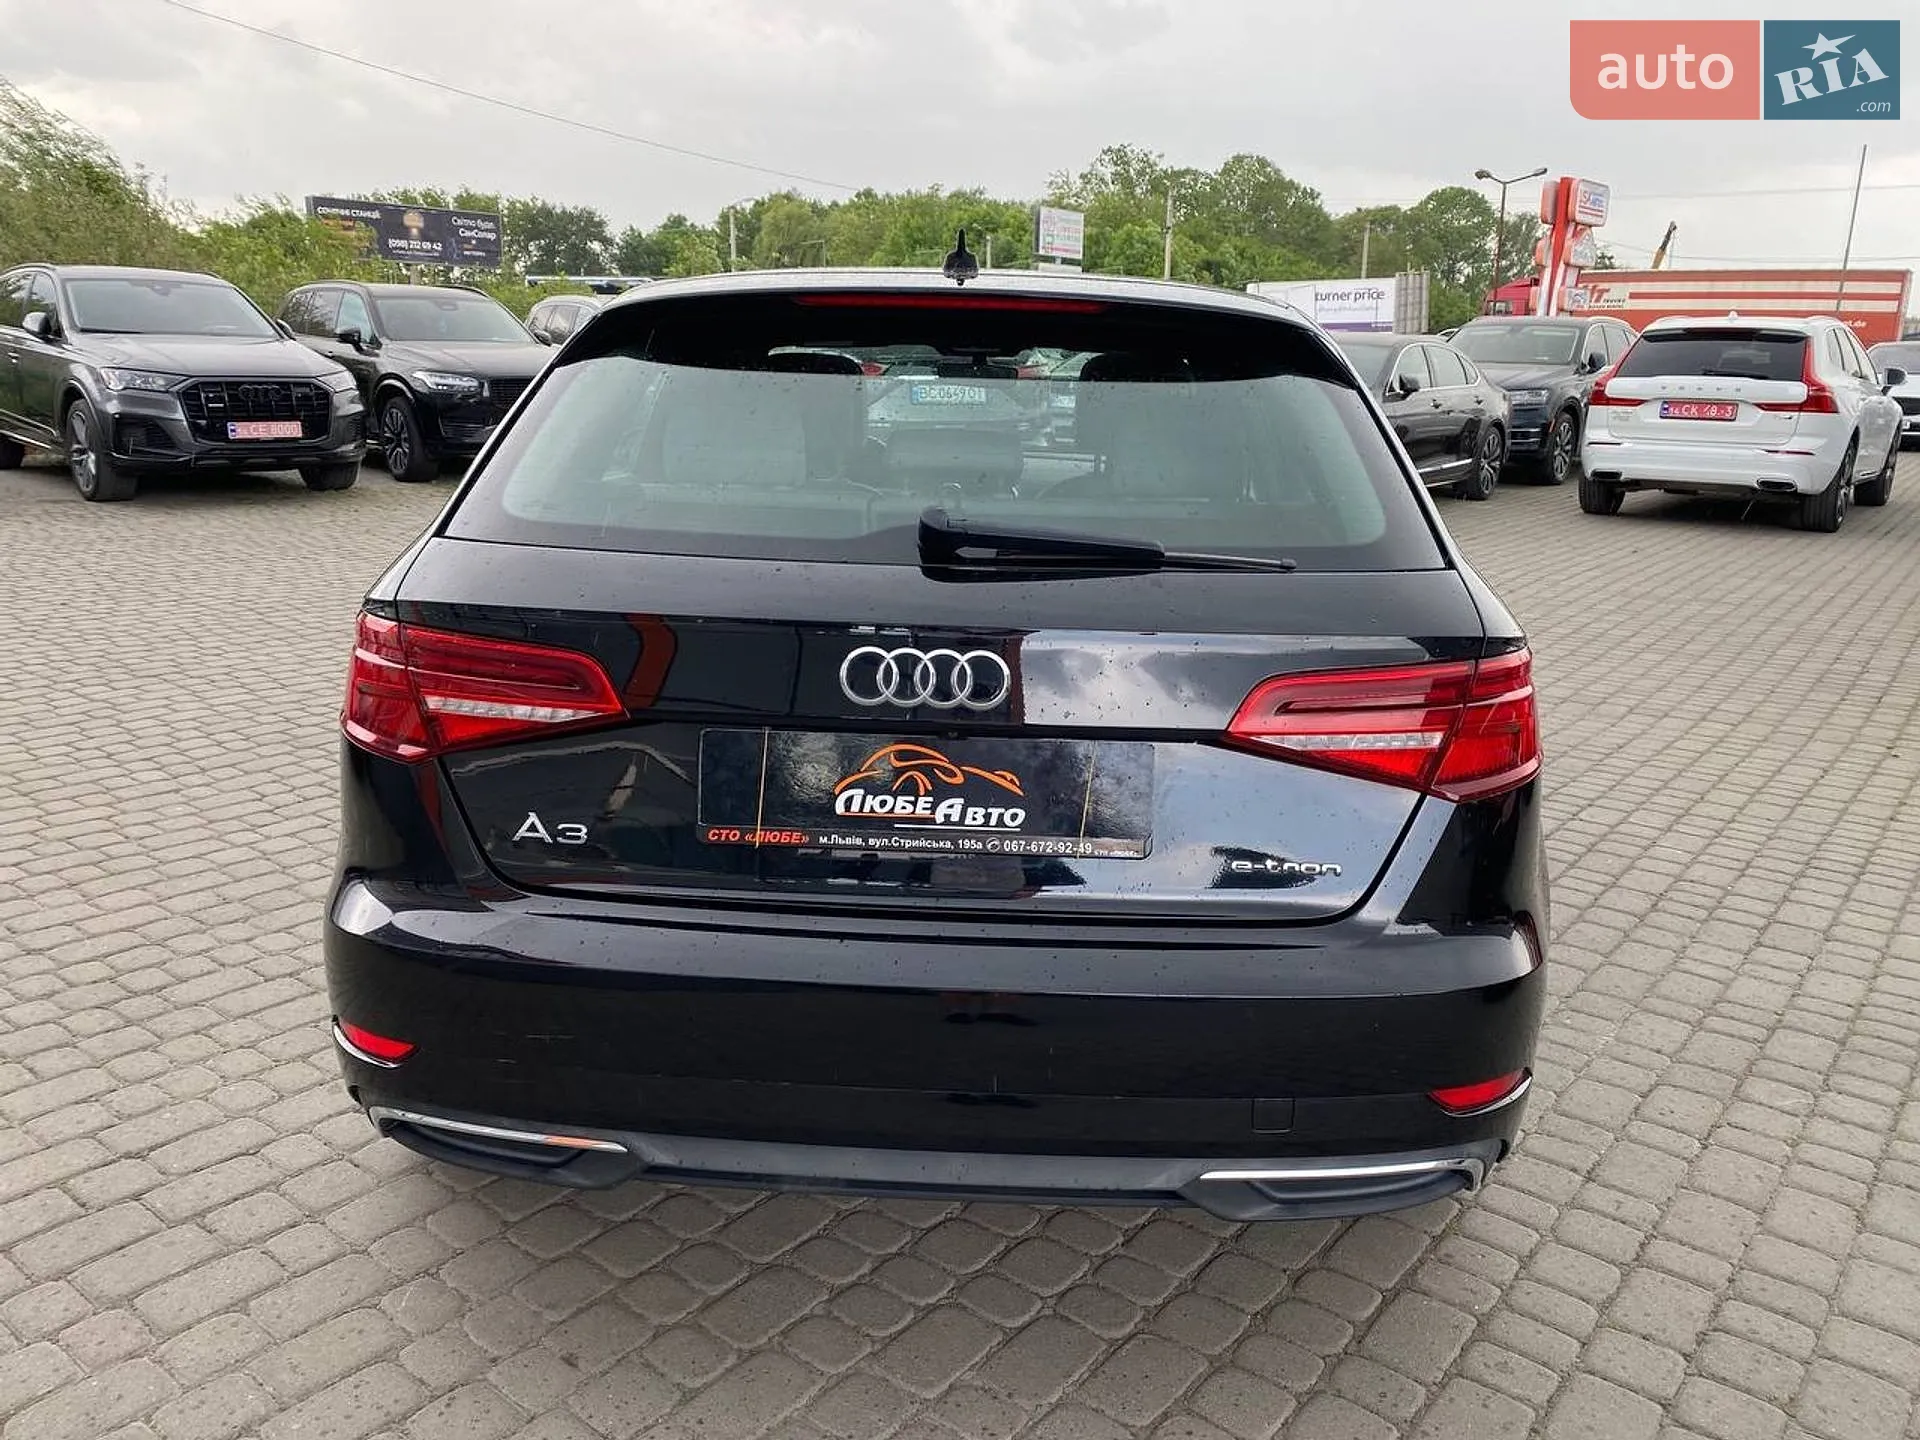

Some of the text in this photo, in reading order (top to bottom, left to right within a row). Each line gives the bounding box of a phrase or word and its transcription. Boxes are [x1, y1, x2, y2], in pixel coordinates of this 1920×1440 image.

[1354, 288, 1385, 302] price
[512, 811, 588, 844] A3
[707, 829, 740, 841] СТО
[1003, 839, 1092, 854] 067-672-92-49
[1231, 858, 1342, 876] e-tron
